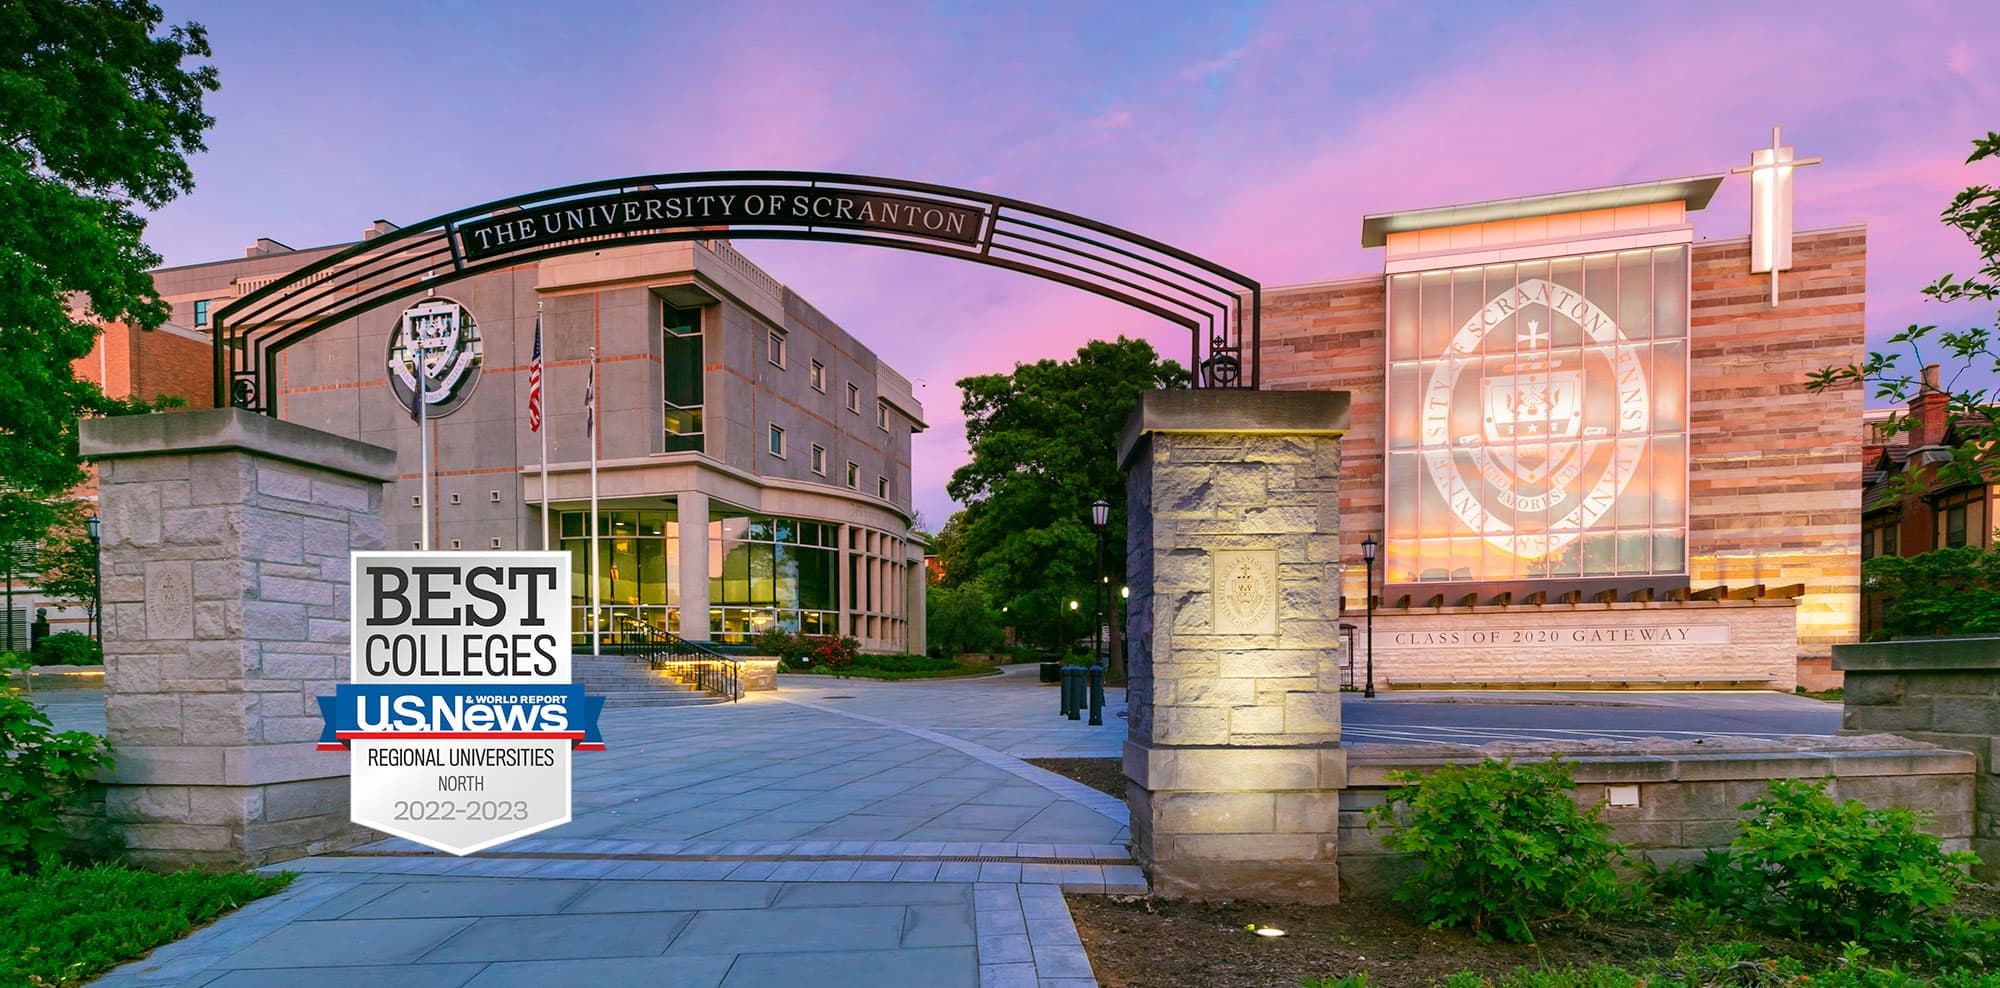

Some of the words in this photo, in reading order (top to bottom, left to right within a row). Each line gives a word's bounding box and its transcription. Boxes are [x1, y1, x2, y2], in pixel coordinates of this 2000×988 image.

[475, 218, 537, 250] THE
[545, 194, 737, 234] UNIVERSITY
[744, 194, 784, 217] OF
[792, 196, 967, 234] SCRANTON
[1468, 282, 1608, 337] SCRANTON
[1395, 631, 1460, 645] CLASS
[1473, 631, 1501, 644] OF
[1513, 630, 1560, 643] 2020
[1572, 628, 1691, 642] GATEWAY
